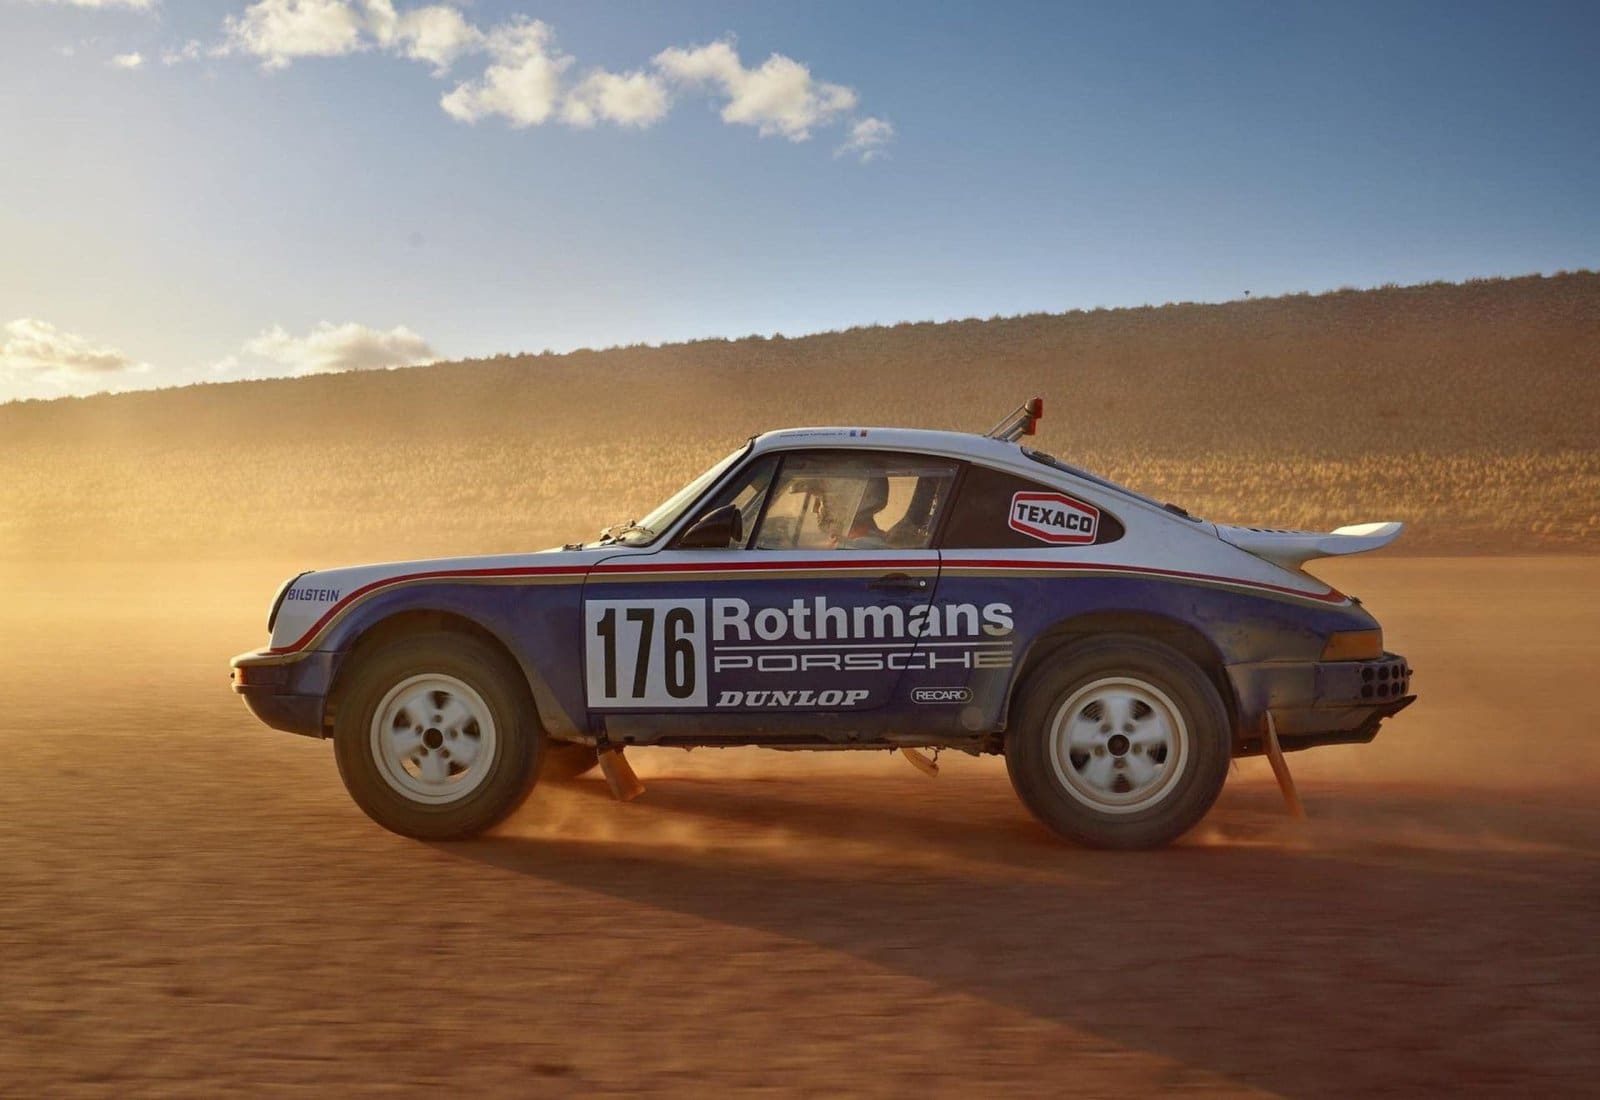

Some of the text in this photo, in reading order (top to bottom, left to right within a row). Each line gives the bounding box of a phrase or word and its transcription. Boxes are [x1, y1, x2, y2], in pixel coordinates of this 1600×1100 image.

[1016, 503, 1093, 533] TEXACO
[288, 588, 340, 602] BILSTEIN
[712, 597, 1014, 641] Rothmans
[597, 607, 696, 699] 176
[714, 651, 1013, 672] PORSCHE
[716, 690, 870, 707] DUNLOP
[916, 691, 968, 700] RECARO
